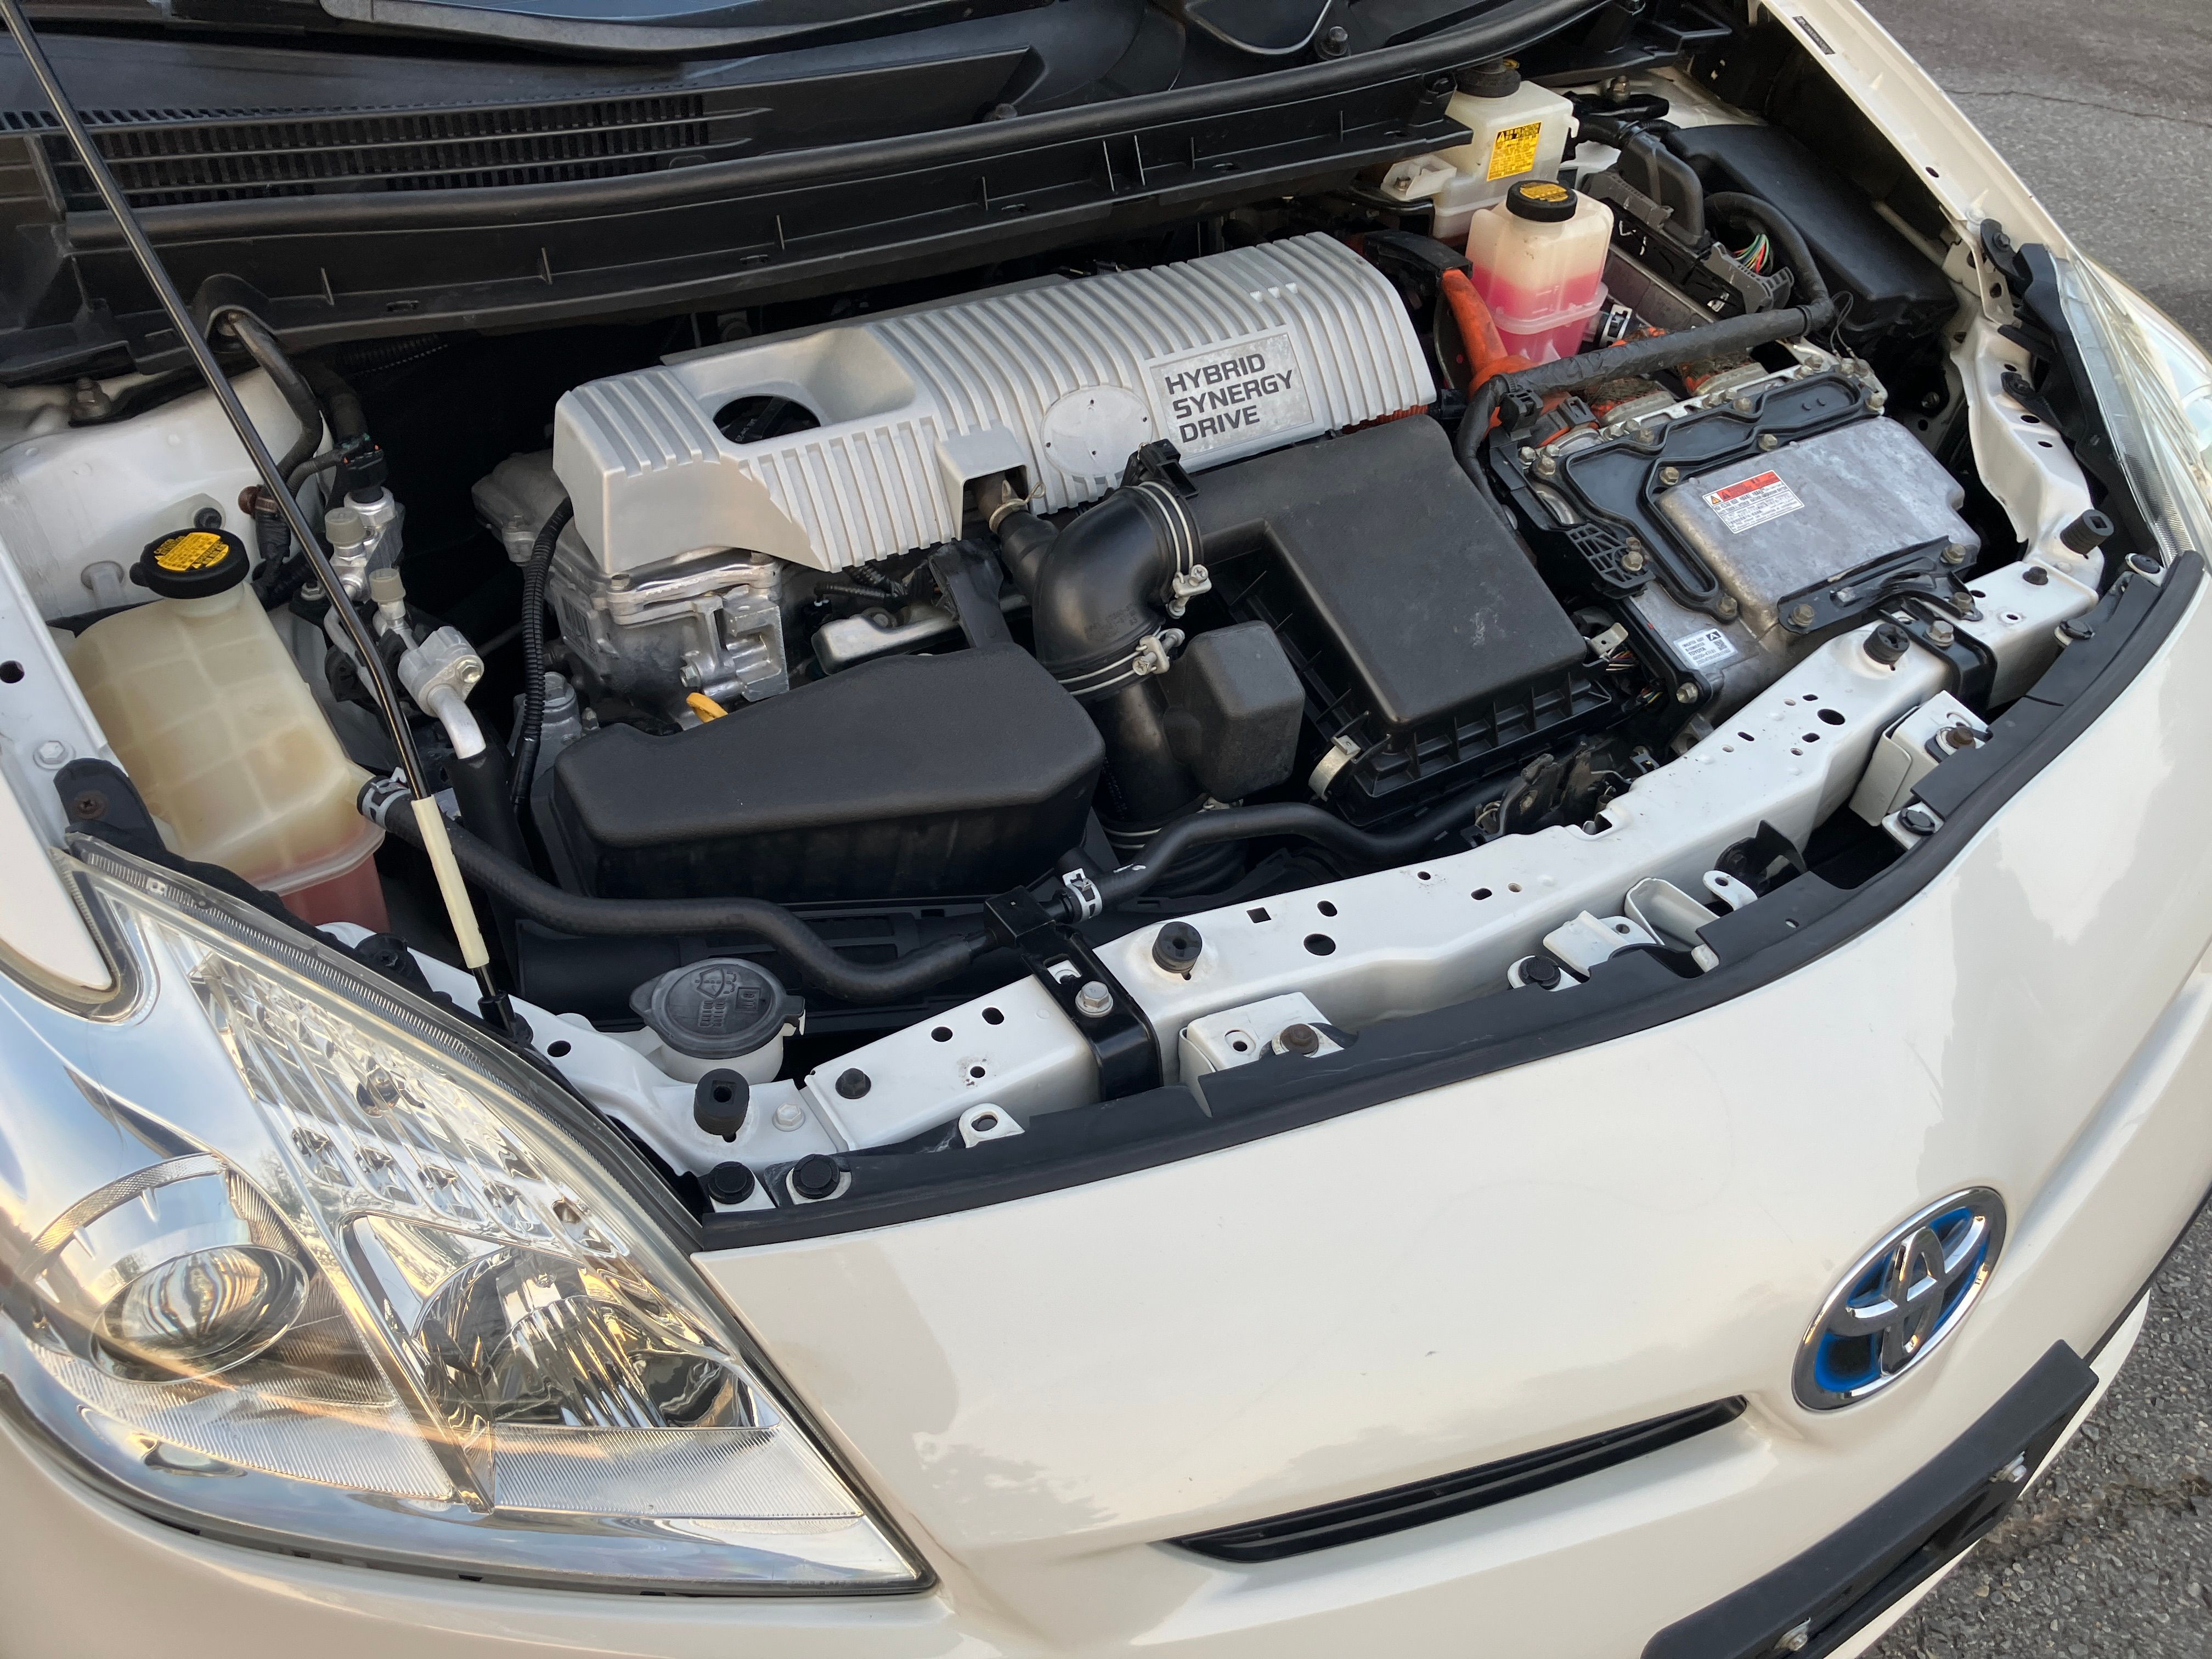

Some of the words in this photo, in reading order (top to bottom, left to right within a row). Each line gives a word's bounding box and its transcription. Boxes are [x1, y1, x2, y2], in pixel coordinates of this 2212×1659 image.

[1165, 353, 1266, 394] HYBRID
[1172, 370, 1293, 419] SYNERGY
[1180, 405, 1260, 443] DRIVE
[1688, 647, 1707, 656] TOYOTA
